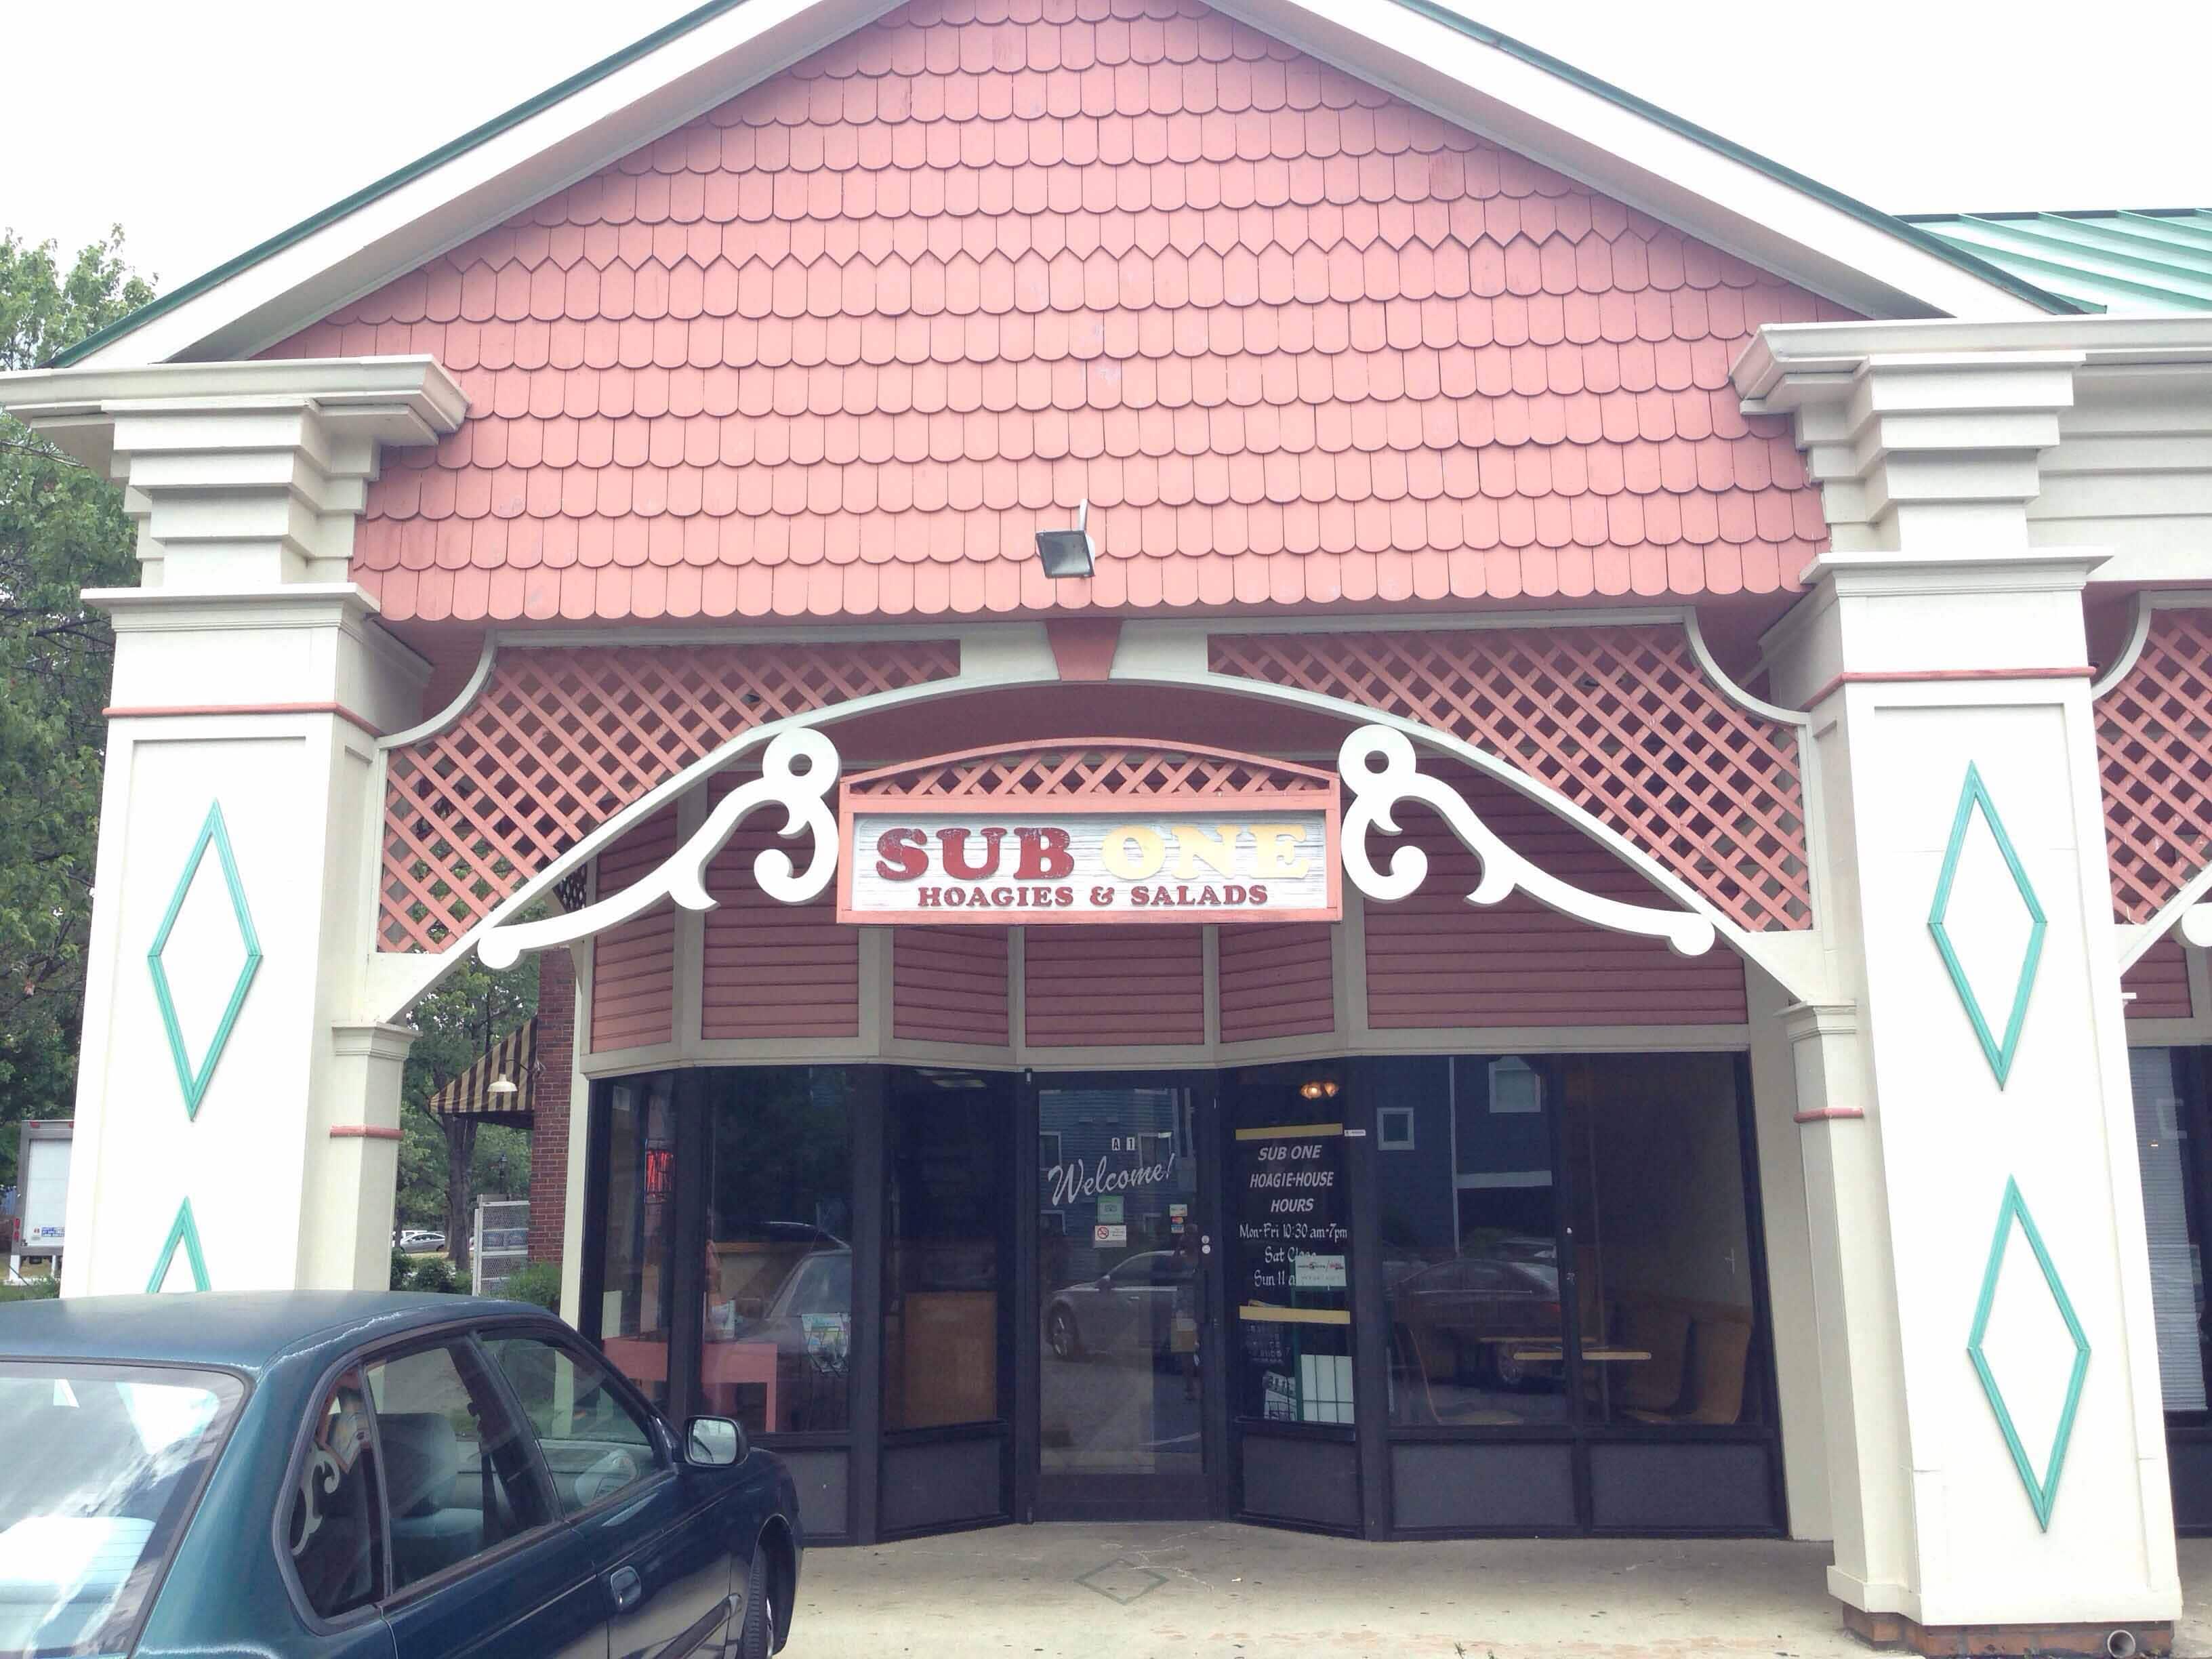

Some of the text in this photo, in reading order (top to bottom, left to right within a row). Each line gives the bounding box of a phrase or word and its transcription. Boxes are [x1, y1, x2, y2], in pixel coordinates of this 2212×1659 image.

[876, 824, 1310, 881] SUB ONE
[918, 884, 1269, 907] HOAGIES & SALADS
[1113, 1139, 1120, 1149] A
[1258, 1145, 1322, 1161] SUB ONE
[1048, 1153, 1175, 1206] Welcome!
[1270, 1198, 1314, 1212] HOURS
[1240, 1223, 1279, 1239] Mon-Fri
[1283, 1223, 1308, 1239] 10:30
[1265, 1246, 1285, 1263] Sat
[1254, 1269, 1275, 1287] Sun
[1278, 1270, 1285, 1286] 11
